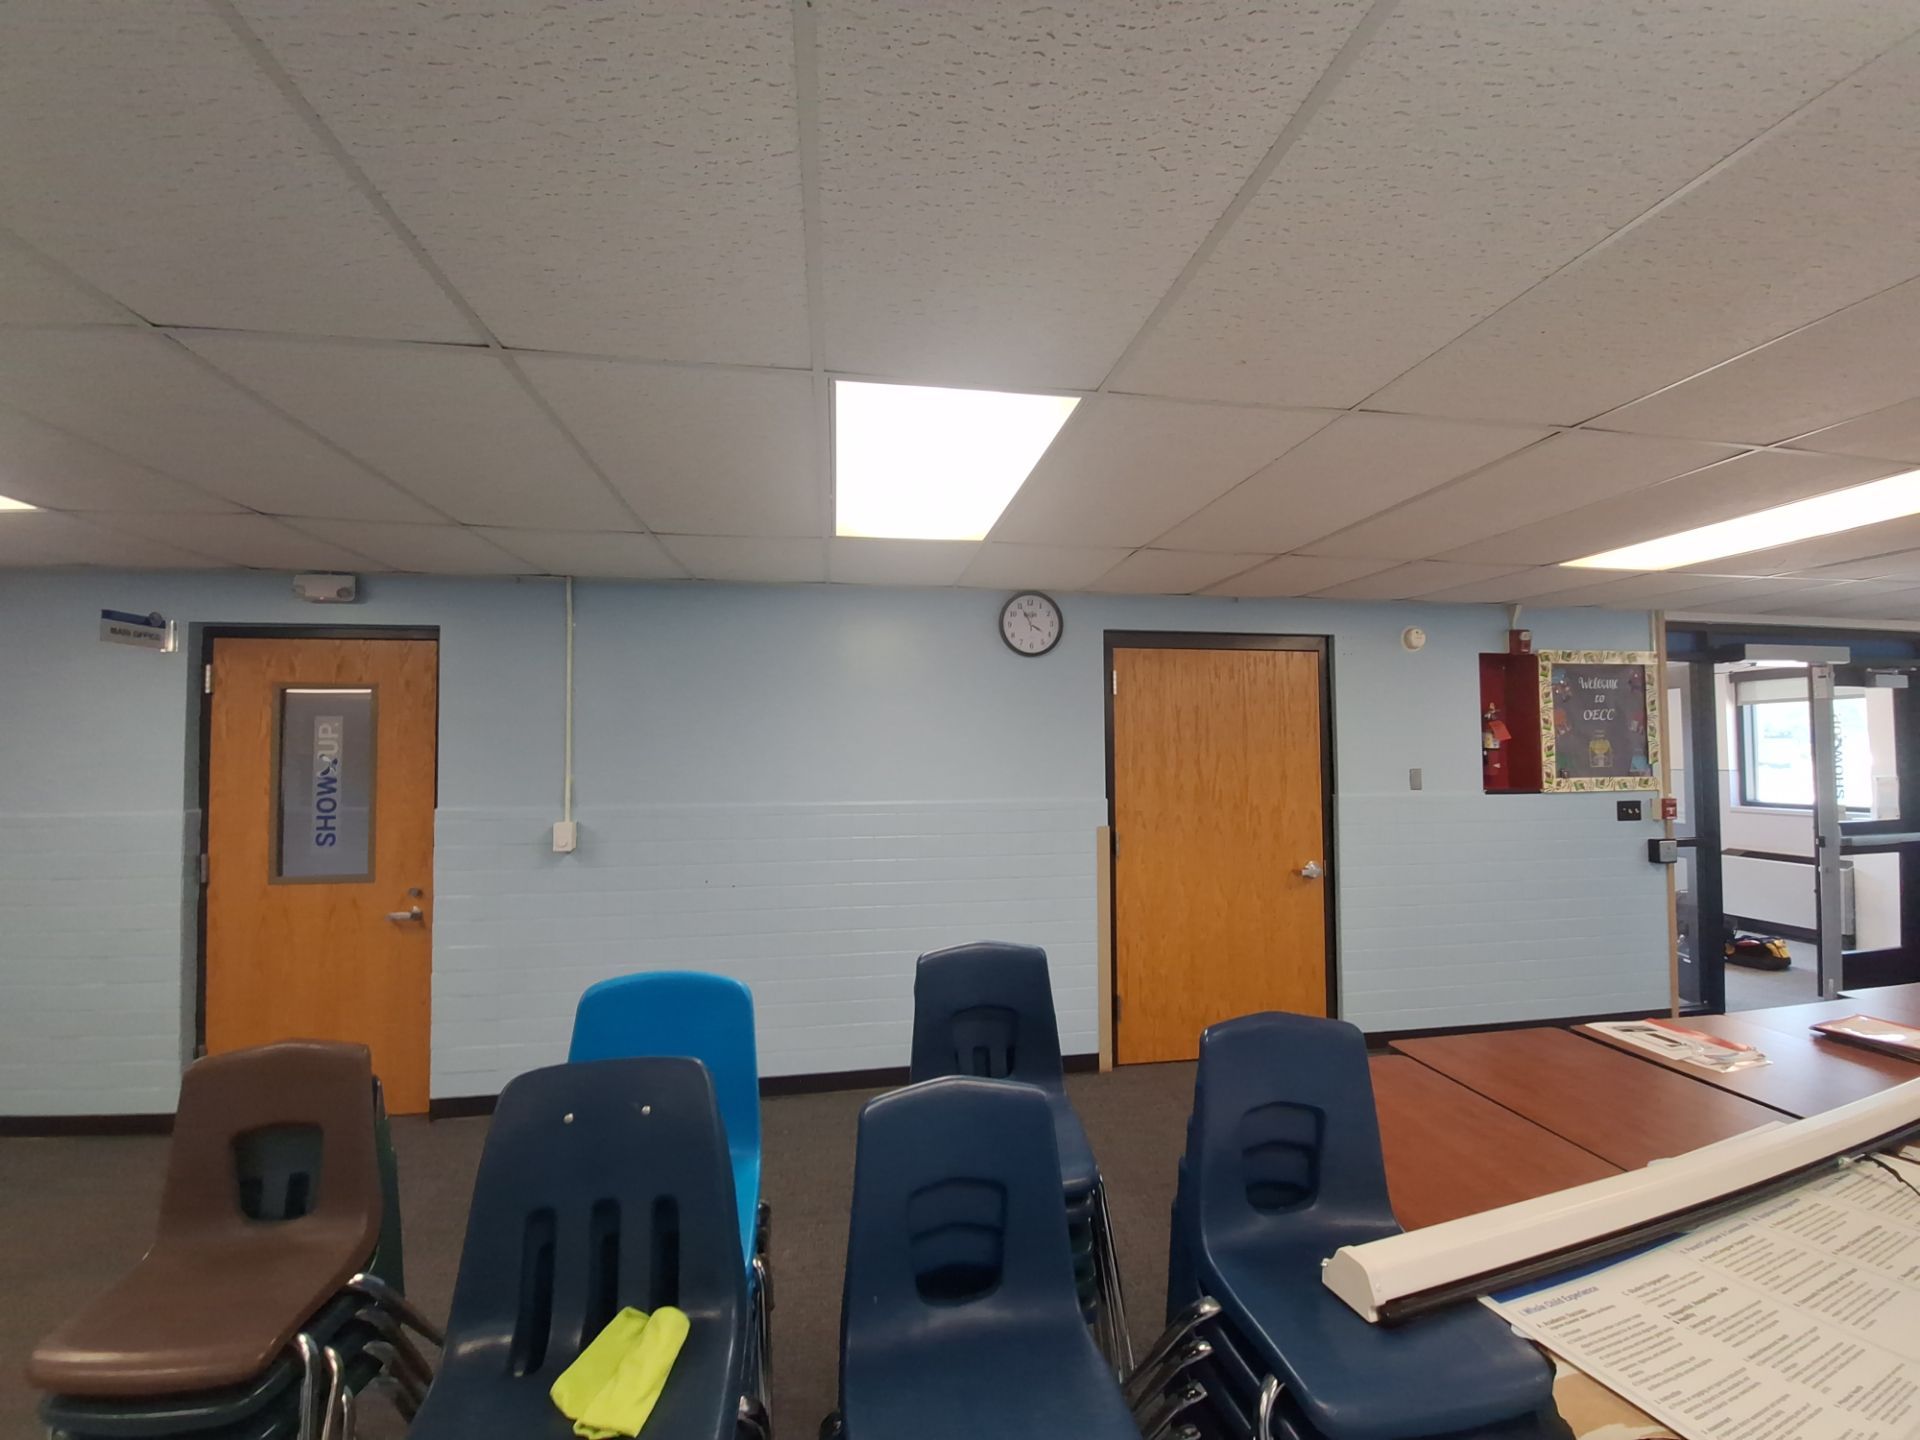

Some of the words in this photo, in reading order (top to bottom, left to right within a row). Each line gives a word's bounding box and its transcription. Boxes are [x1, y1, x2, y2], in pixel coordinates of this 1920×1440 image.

[1594, 695, 1605, 703] to
[1583, 708, 1615, 721] OECC
[315, 776, 338, 847] SHOW
